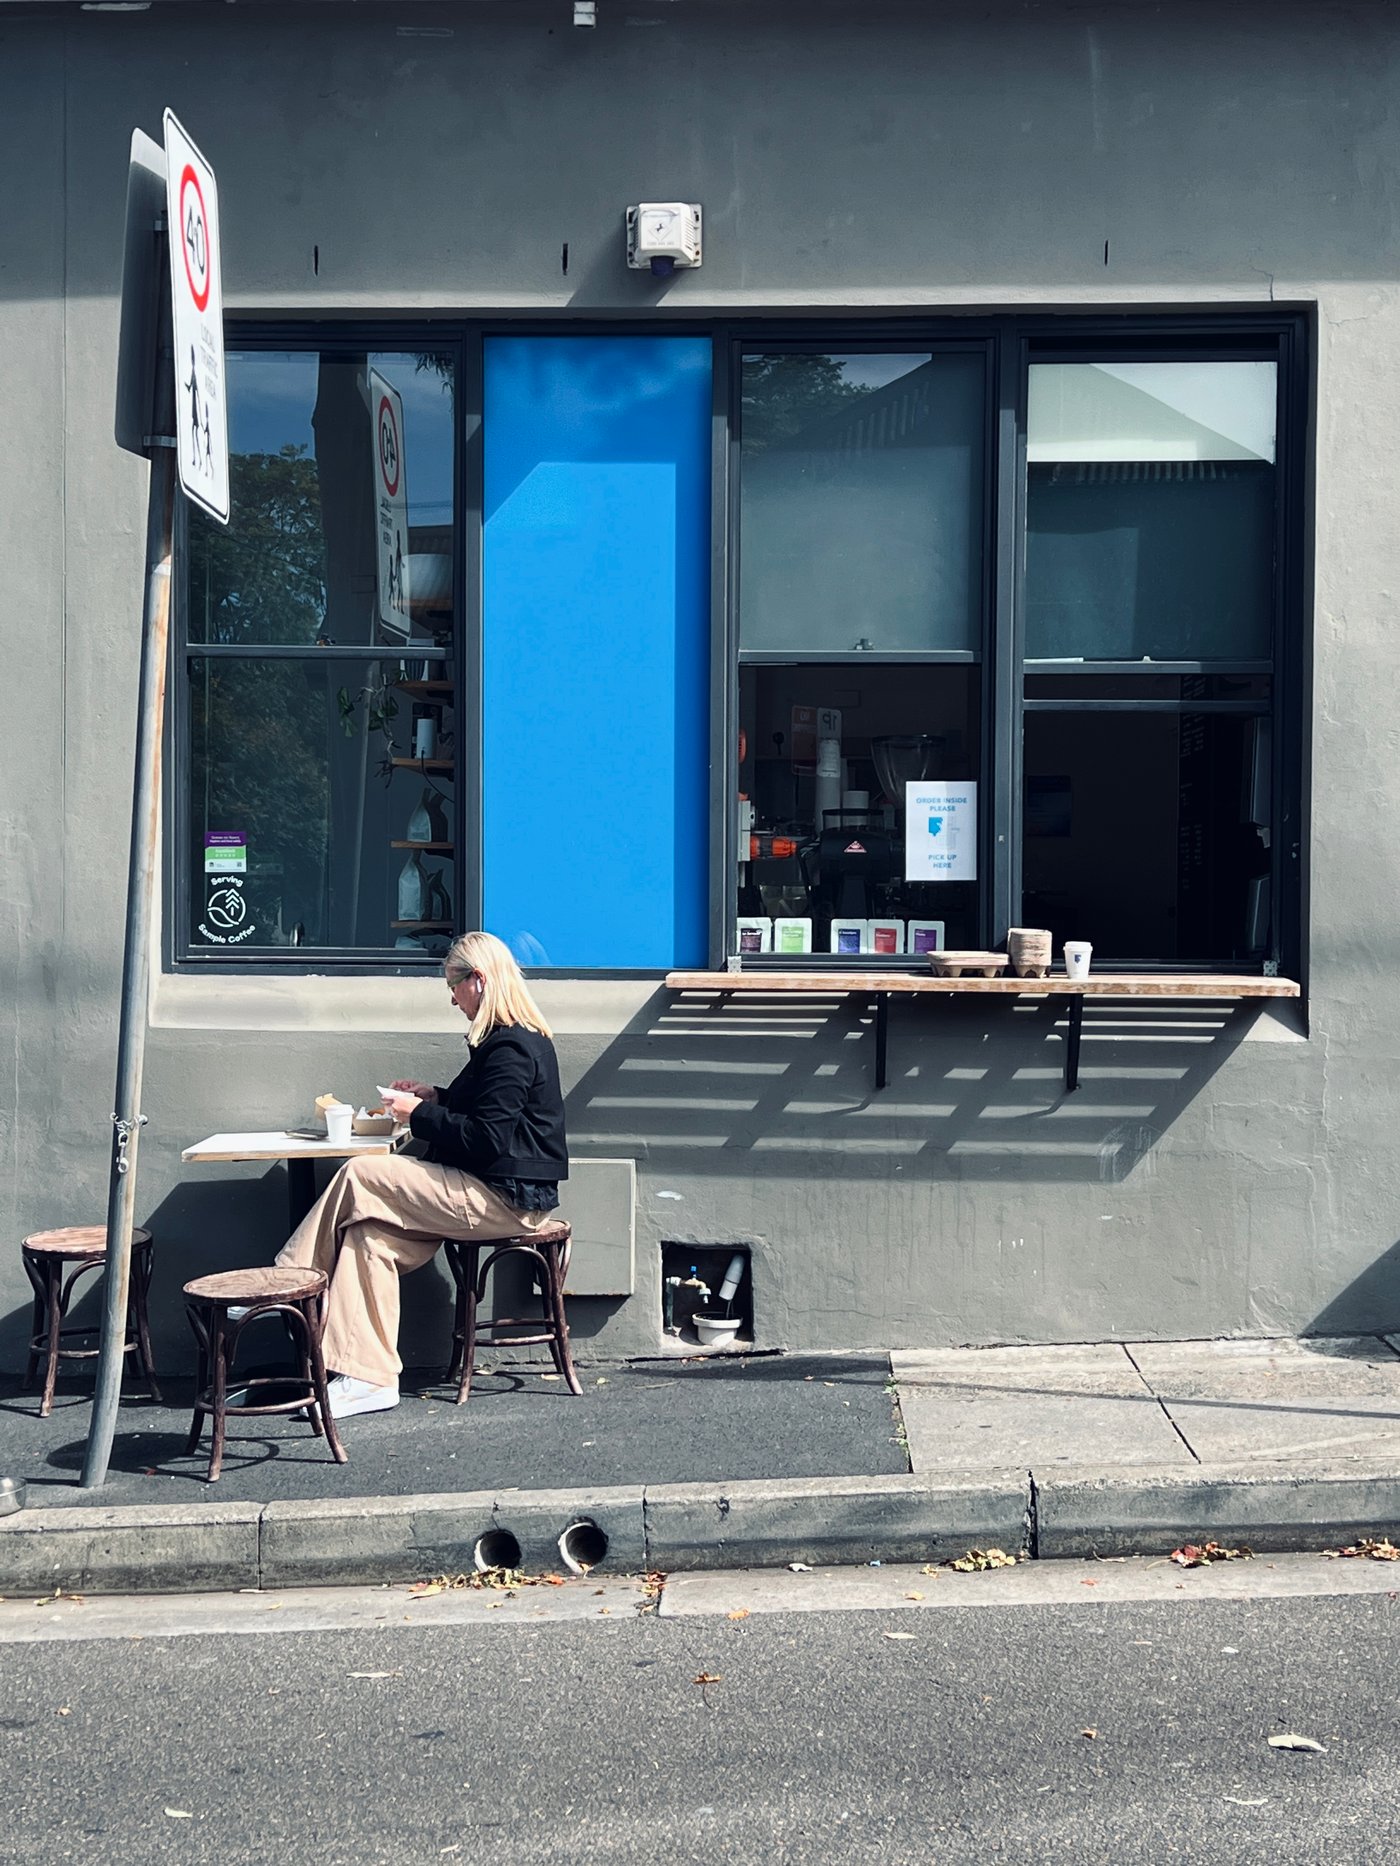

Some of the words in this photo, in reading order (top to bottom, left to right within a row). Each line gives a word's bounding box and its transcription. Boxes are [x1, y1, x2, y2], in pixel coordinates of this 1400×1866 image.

[186, 204, 205, 276] 40
[210, 875, 244, 888] Serving
[198, 923, 227, 944] Sample
[227, 924, 256, 943] Coffee
